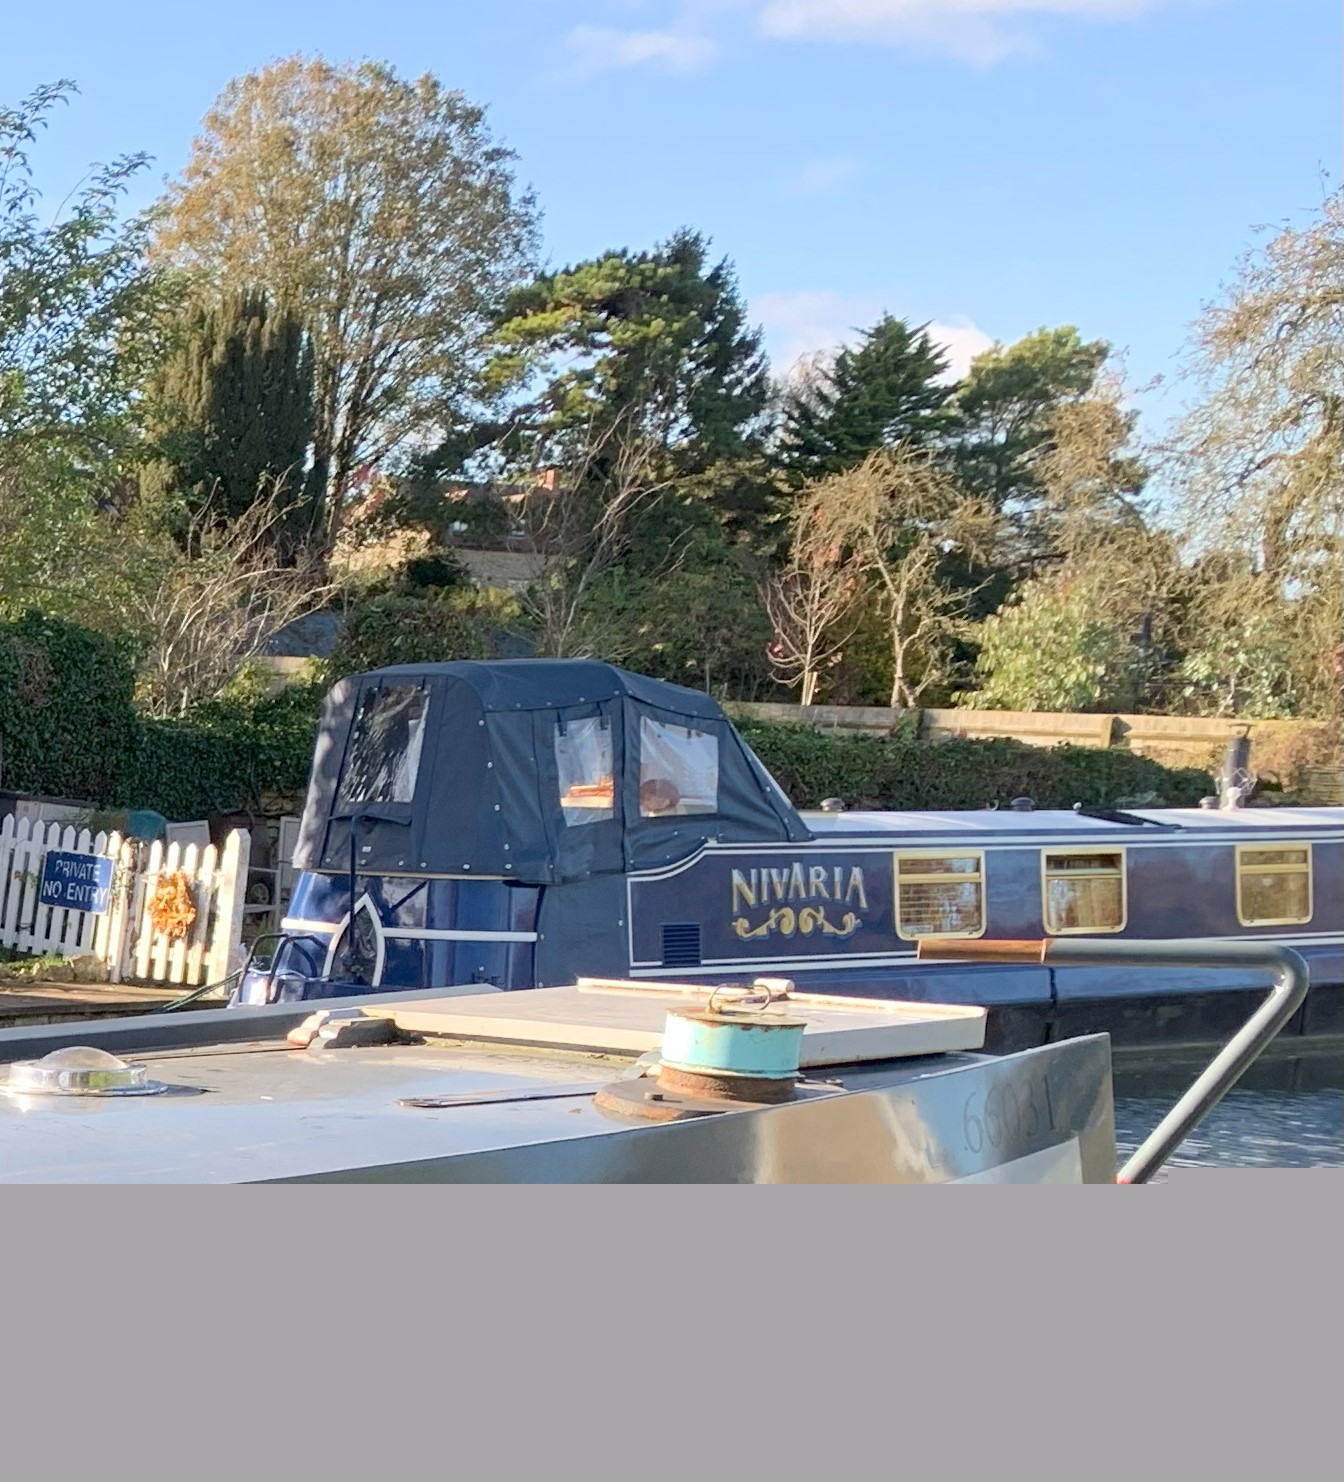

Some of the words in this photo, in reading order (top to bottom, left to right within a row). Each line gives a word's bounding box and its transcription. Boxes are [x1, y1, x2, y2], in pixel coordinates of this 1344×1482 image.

[55, 860, 101, 882] PRIVATE
[43, 881, 62, 898] NO
[67, 883, 108, 904] ENTRY
[732, 862, 869, 914] NIVARIA
